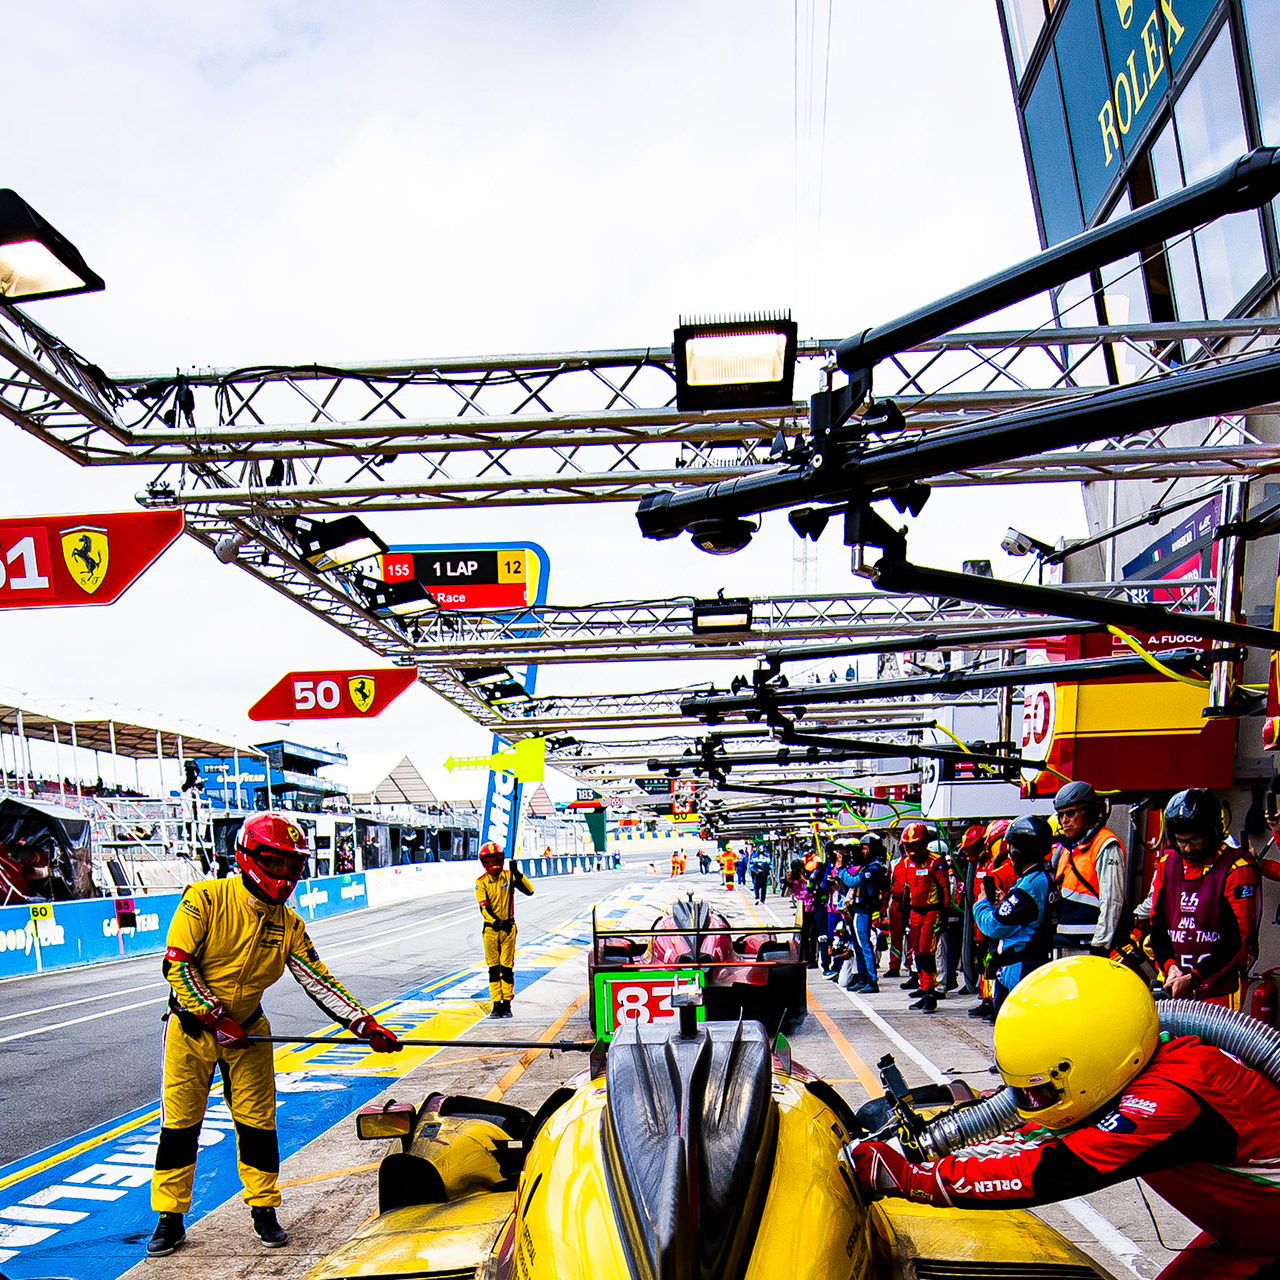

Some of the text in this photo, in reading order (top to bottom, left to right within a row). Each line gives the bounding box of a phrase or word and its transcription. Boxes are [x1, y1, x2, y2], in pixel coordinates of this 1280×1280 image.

[1098, 0, 1185, 167] ROLEX
[387, 564, 410, 576] 155
[433, 560, 478, 577] 1 LAP
[504, 560, 522, 574] 12
[437, 592, 466, 603] Race
[1148, 636, 1160, 644] A.
[294, 680, 341, 711] 50
[577, 789, 594, 800] 183
[31, 906, 48, 918] 60
[115, 901, 131, 911] 85
[616, 986, 681, 1026] 83
[974, 1178, 1023, 1193] ORLEN
